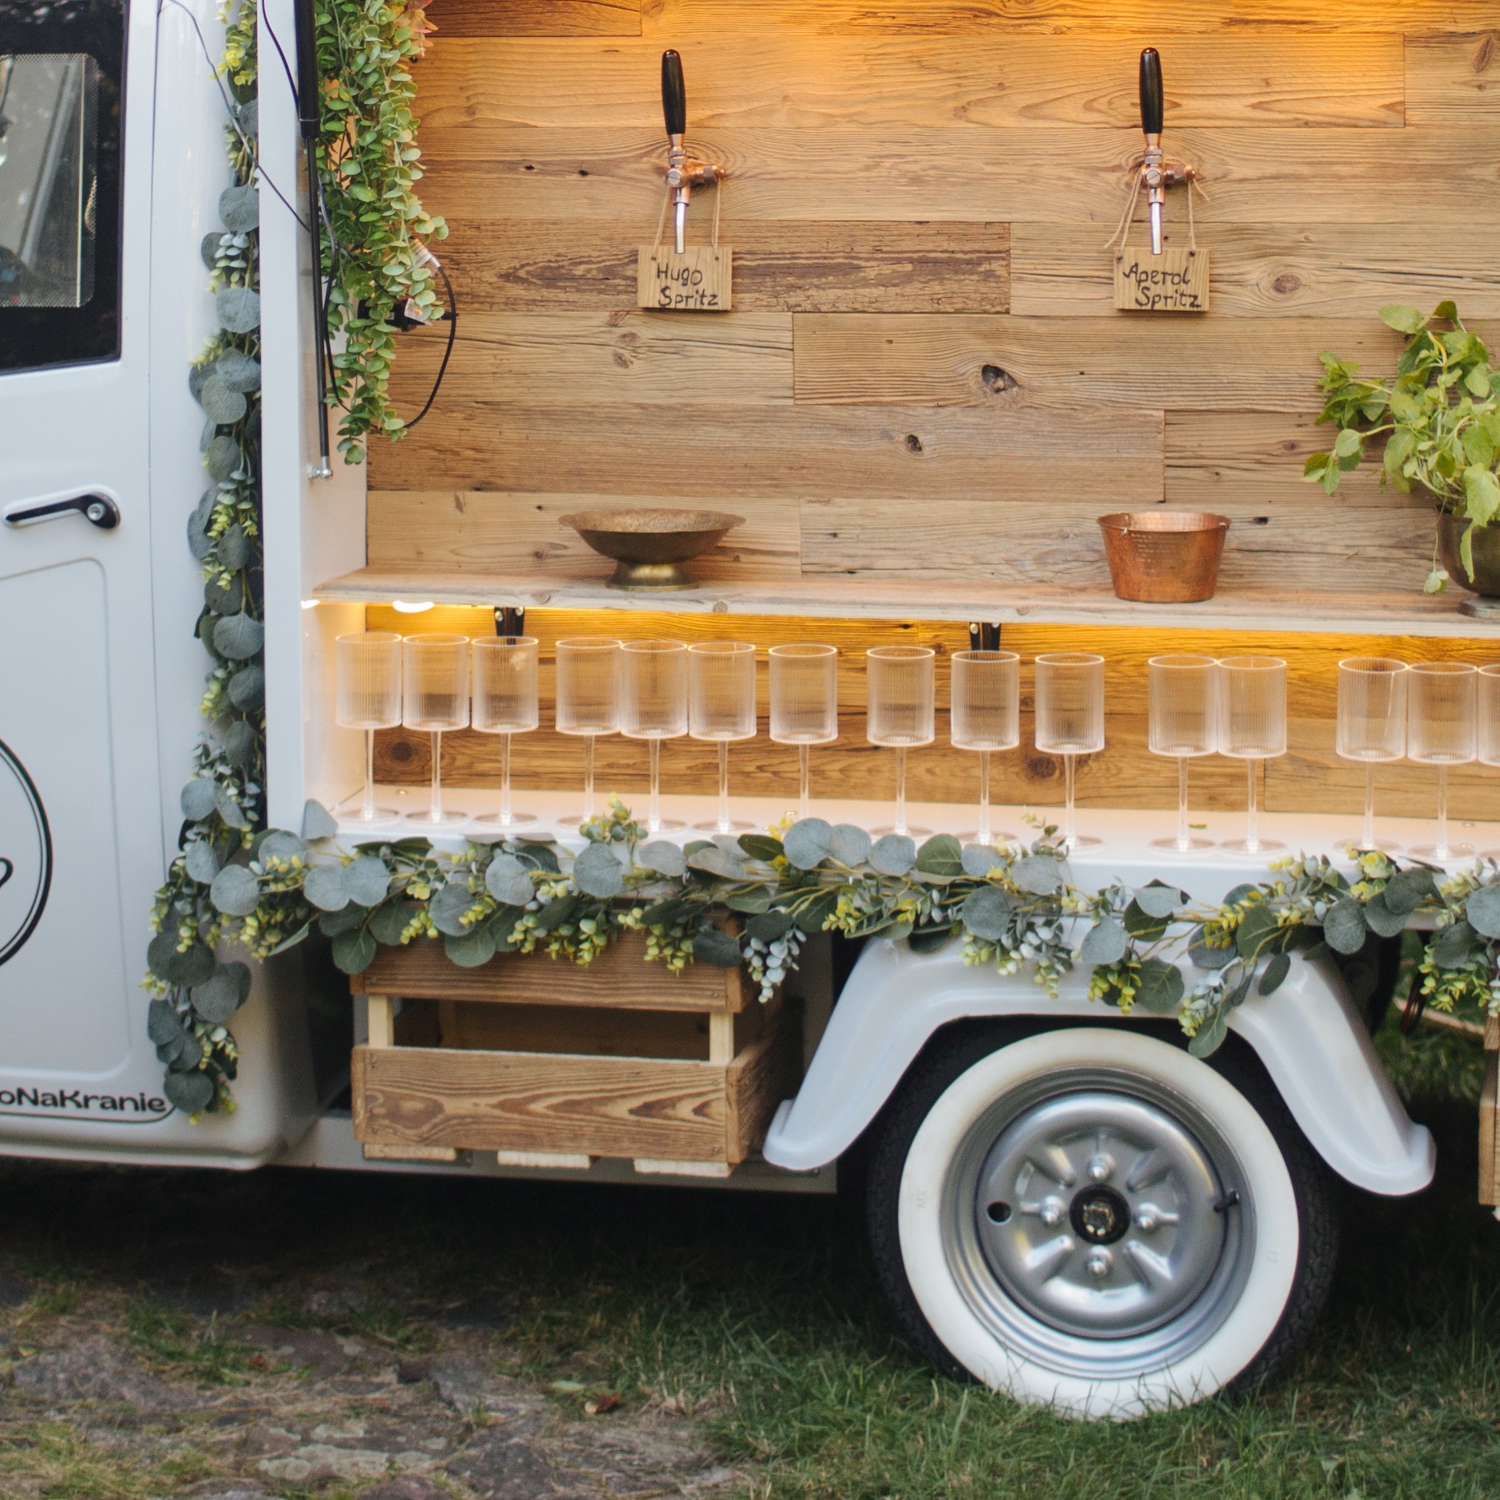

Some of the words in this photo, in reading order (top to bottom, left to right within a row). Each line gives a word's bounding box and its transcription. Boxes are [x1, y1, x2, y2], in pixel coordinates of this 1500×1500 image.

[656, 262, 703, 287] Hugo
[1122, 262, 1191, 290] Aperol
[658, 285, 719, 308] Spritz
[1134, 286, 1202, 309] Spritz
